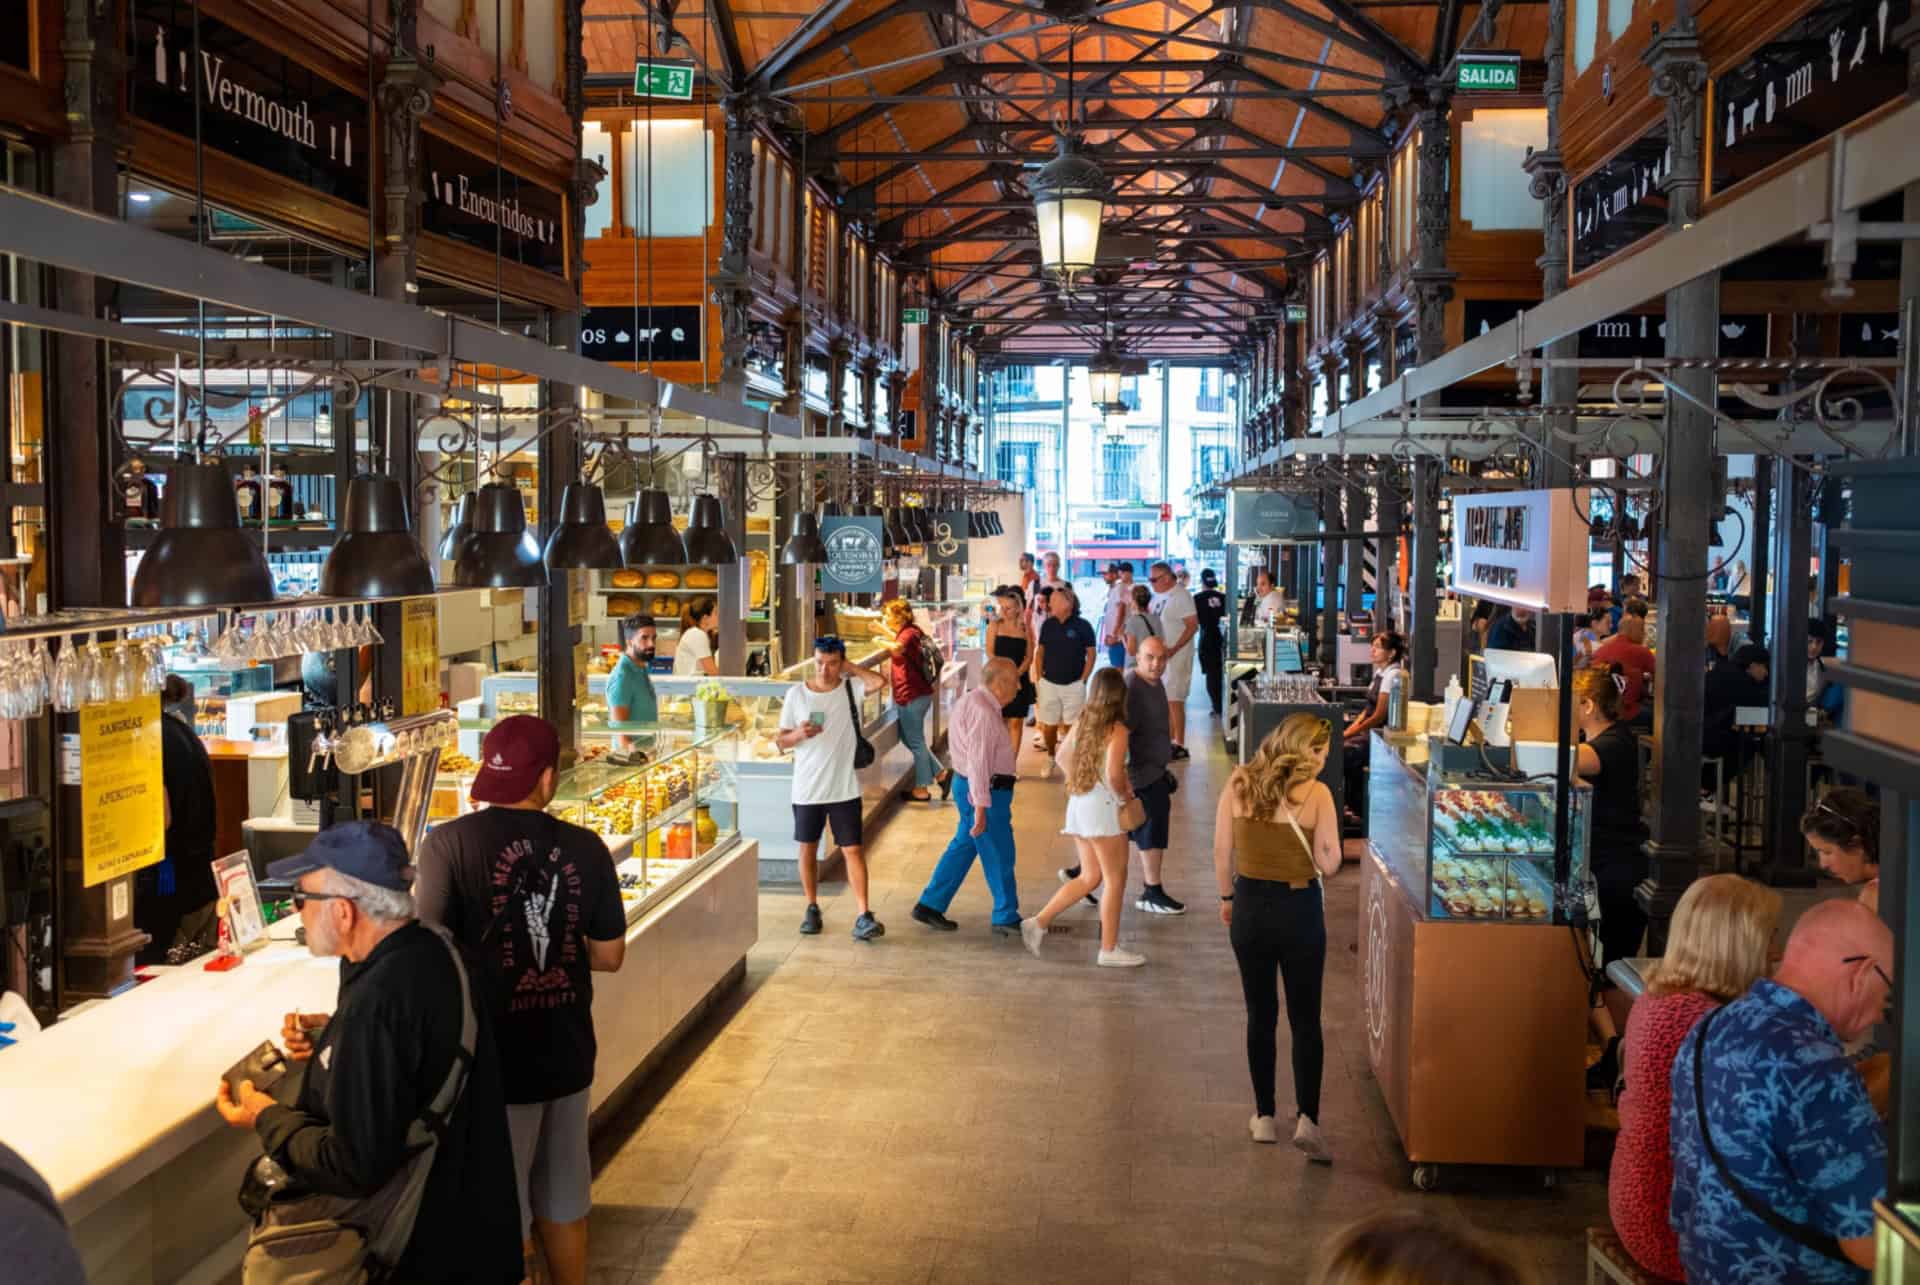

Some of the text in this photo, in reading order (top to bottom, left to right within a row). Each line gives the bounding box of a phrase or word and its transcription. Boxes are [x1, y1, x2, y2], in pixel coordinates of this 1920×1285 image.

[200, 50, 317, 149] Vermouth
[1460, 68, 1516, 85] SALIDA
[458, 174, 535, 239] Encurtidos
